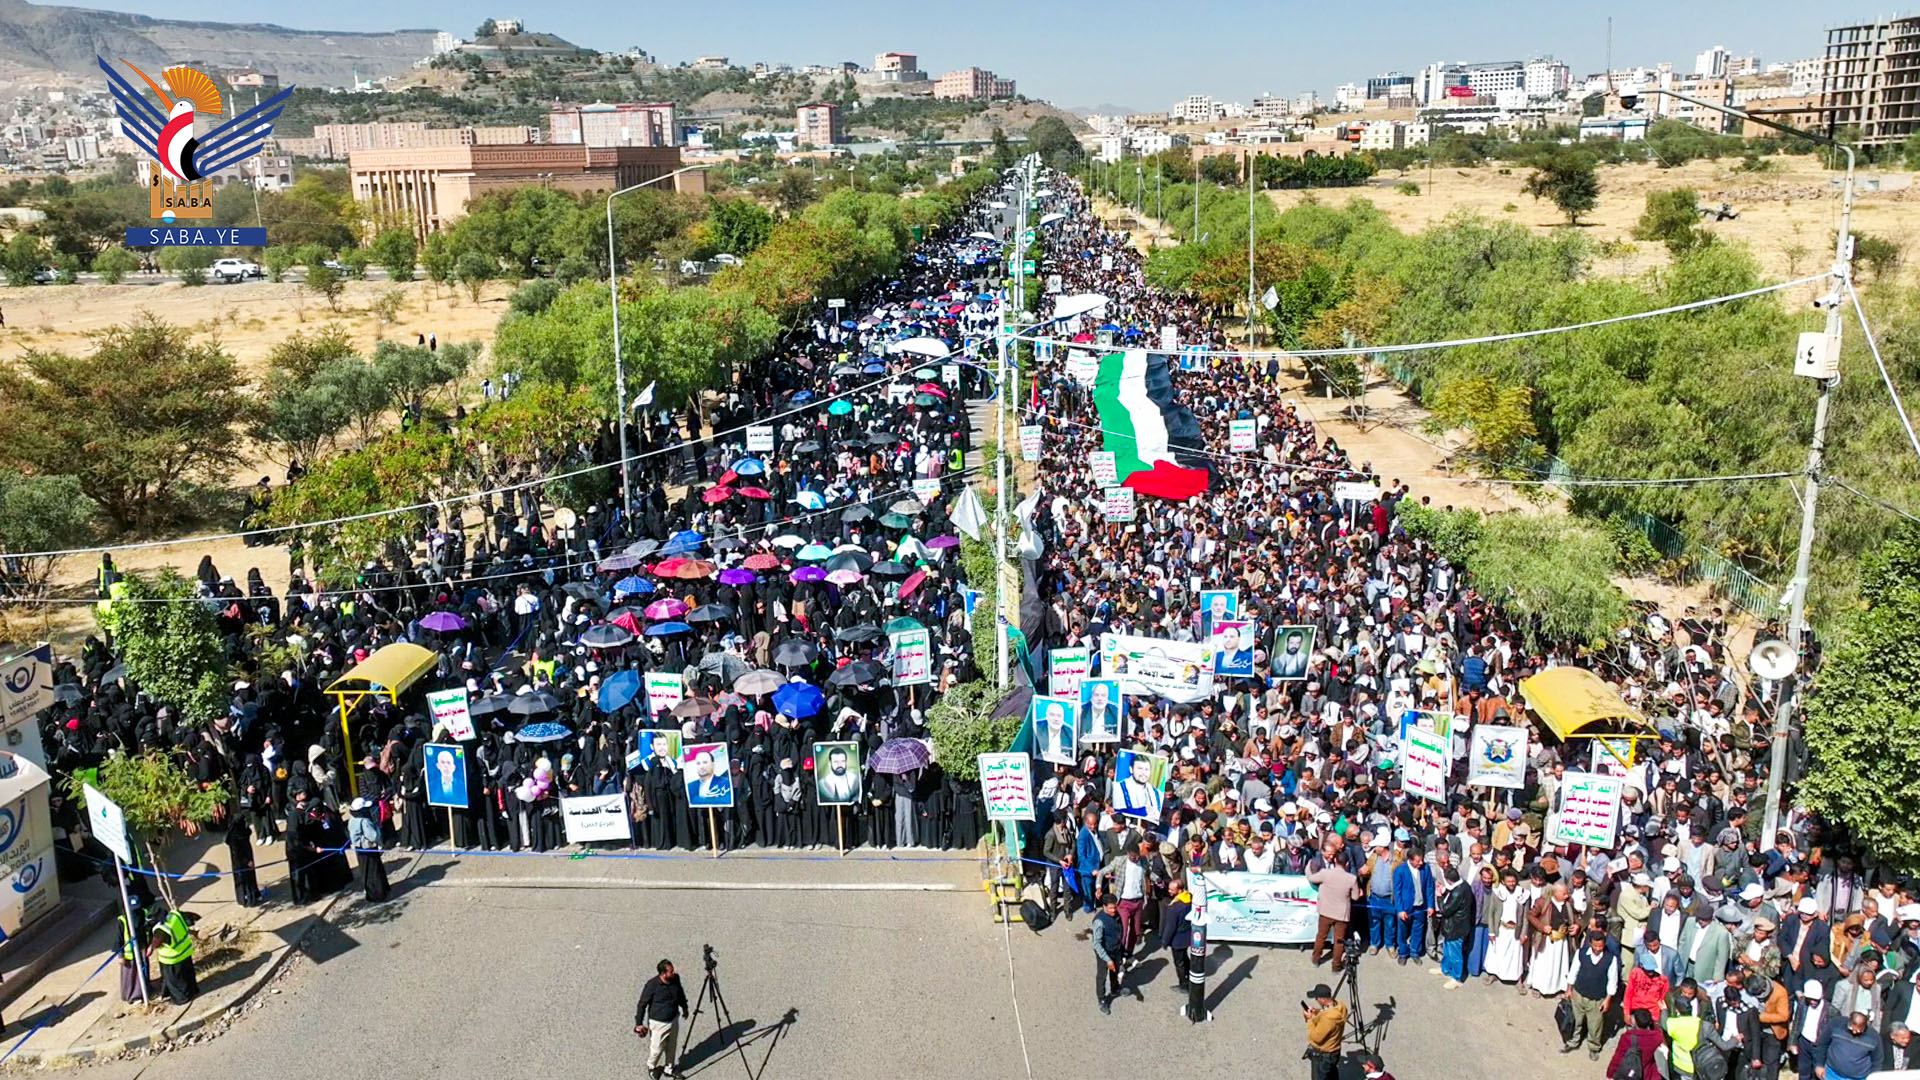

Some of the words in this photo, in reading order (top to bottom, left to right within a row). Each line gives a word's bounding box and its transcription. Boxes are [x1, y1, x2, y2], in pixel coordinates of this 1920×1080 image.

[987, 758, 1008, 774] أكبر
[1009, 761, 1025, 771] الله
[1569, 781, 1597, 794] أكبر
[1598, 785, 1616, 794] الله
[569, 806, 602, 816] الهندسة
[605, 804, 622, 816] كلية
